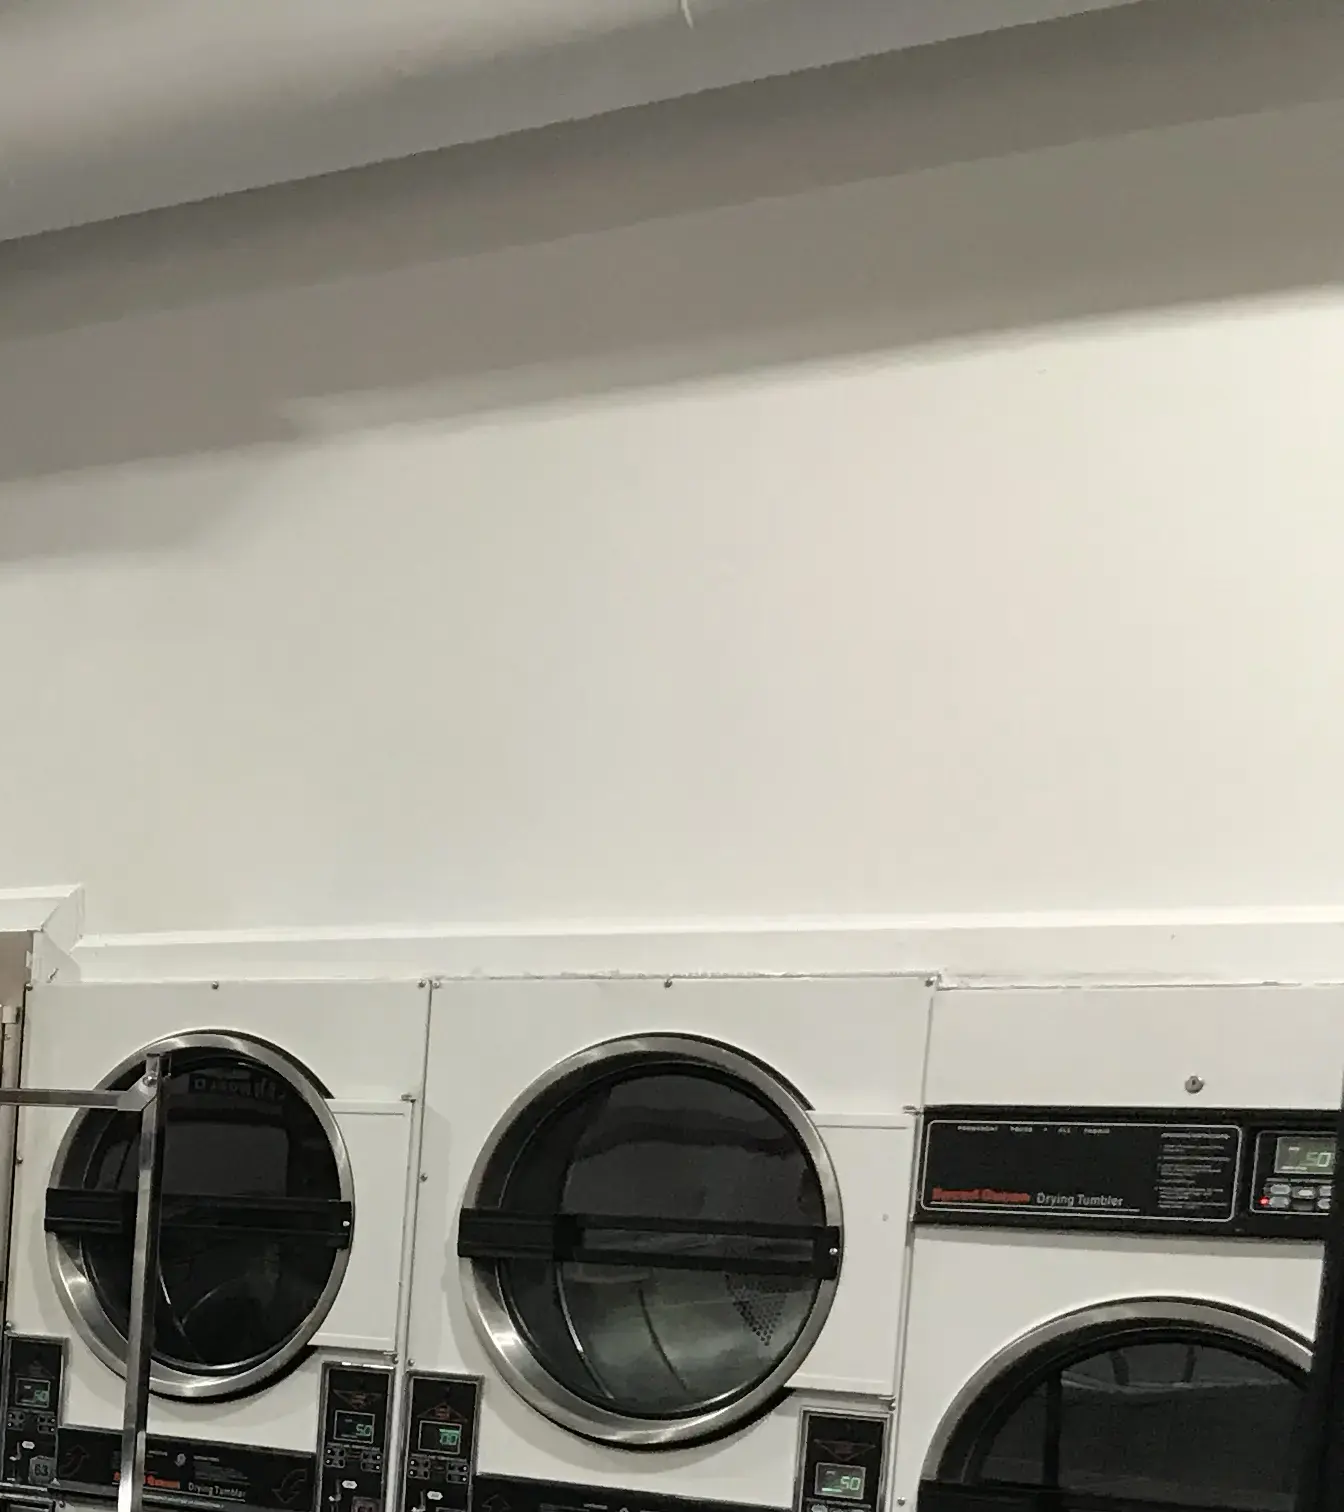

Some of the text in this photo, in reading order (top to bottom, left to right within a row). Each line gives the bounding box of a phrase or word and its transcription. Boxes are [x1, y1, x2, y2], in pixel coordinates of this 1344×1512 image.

[1036, 1192, 1075, 1206] Drying
[1077, 1193, 1124, 1206] Tumbler
[840, 1475, 861, 1491] 50
